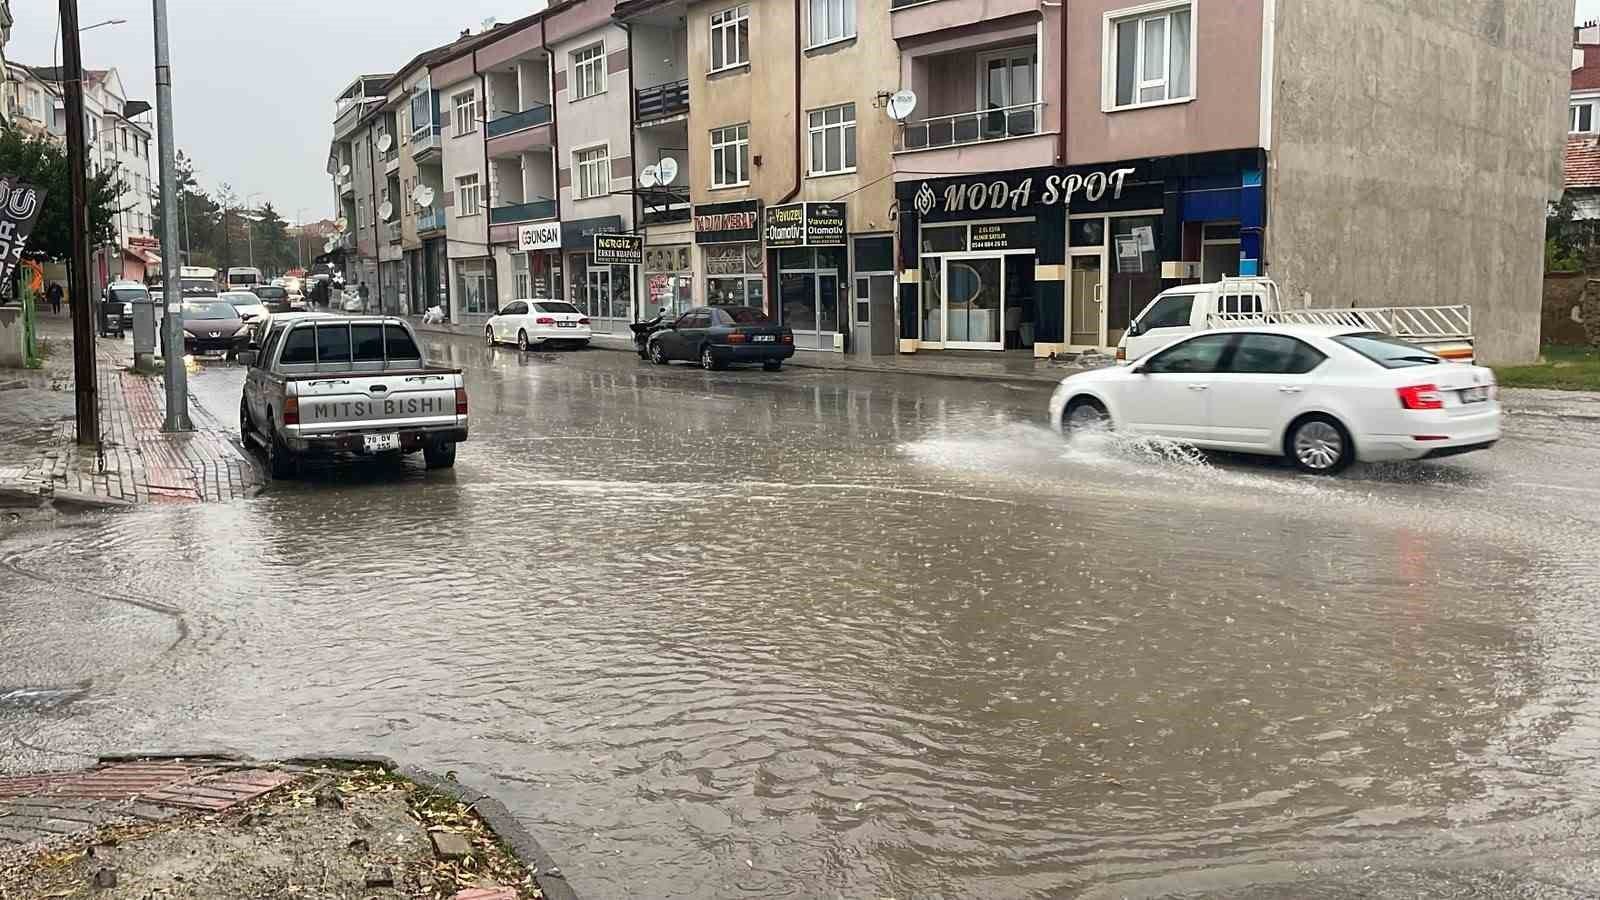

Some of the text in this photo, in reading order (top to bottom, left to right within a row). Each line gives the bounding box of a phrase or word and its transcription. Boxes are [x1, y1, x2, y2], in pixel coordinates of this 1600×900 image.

[943, 167, 1136, 212] MODA SPOT
[775, 207, 803, 224] Yavuzey
[807, 218, 843, 226] Yavuzey
[769, 223, 800, 240] Otomotiv
[808, 226, 844, 234] Otomotiv
